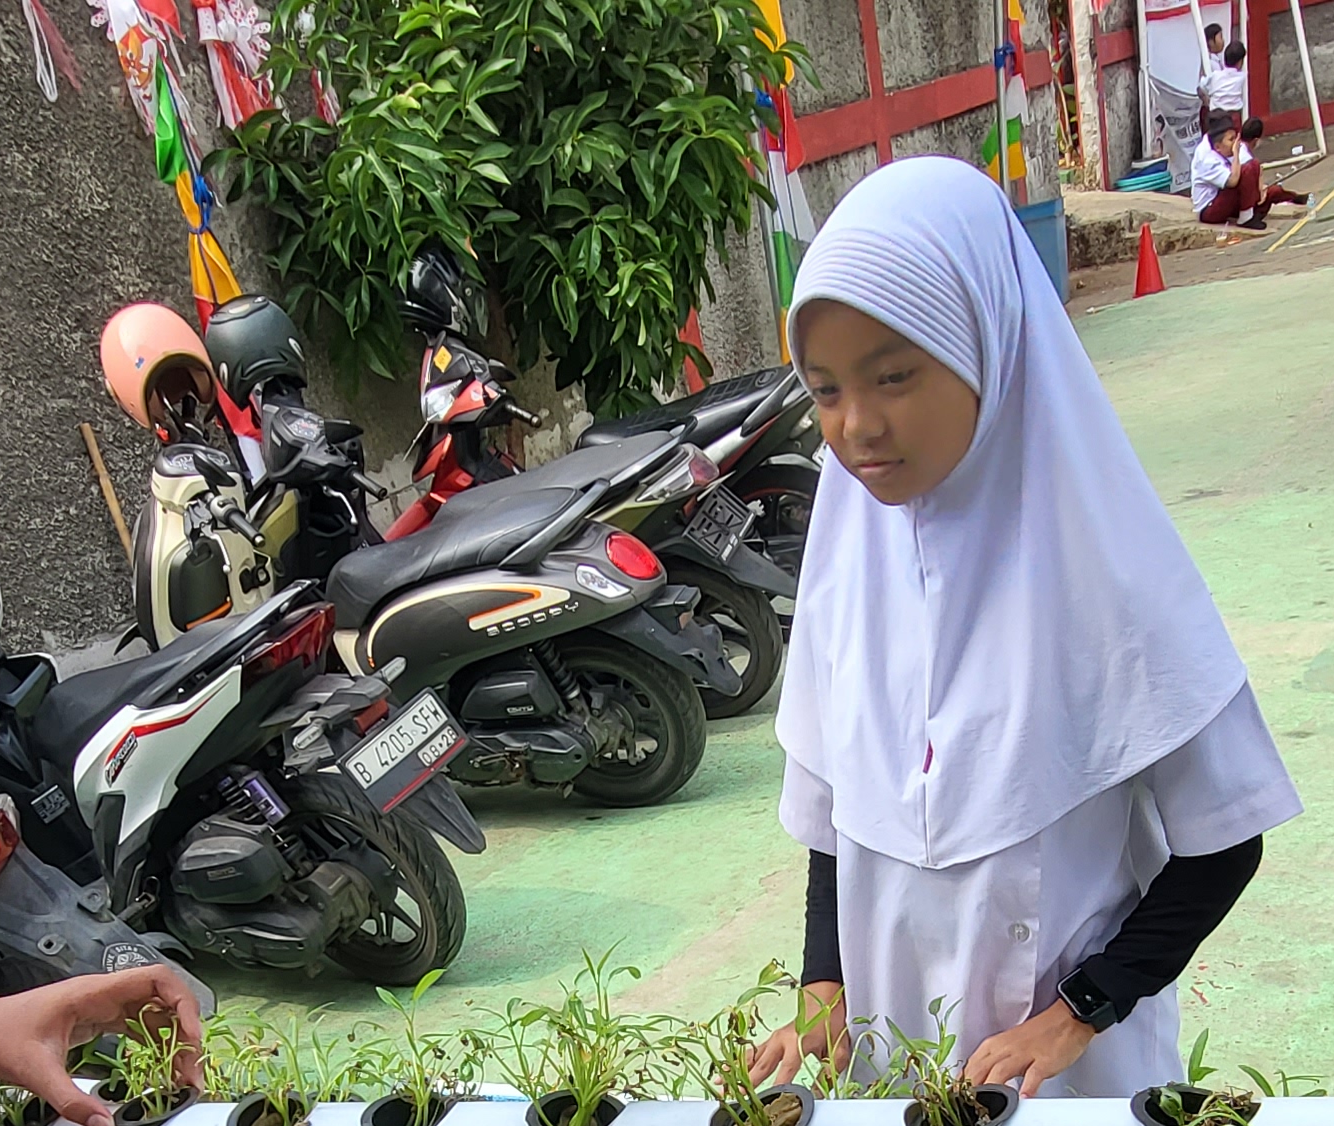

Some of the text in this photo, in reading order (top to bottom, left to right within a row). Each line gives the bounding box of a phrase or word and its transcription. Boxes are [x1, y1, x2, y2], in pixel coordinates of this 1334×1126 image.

[486, 601, 579, 637] SCOOPY
[353, 700, 443, 784] B 4205 SFW
